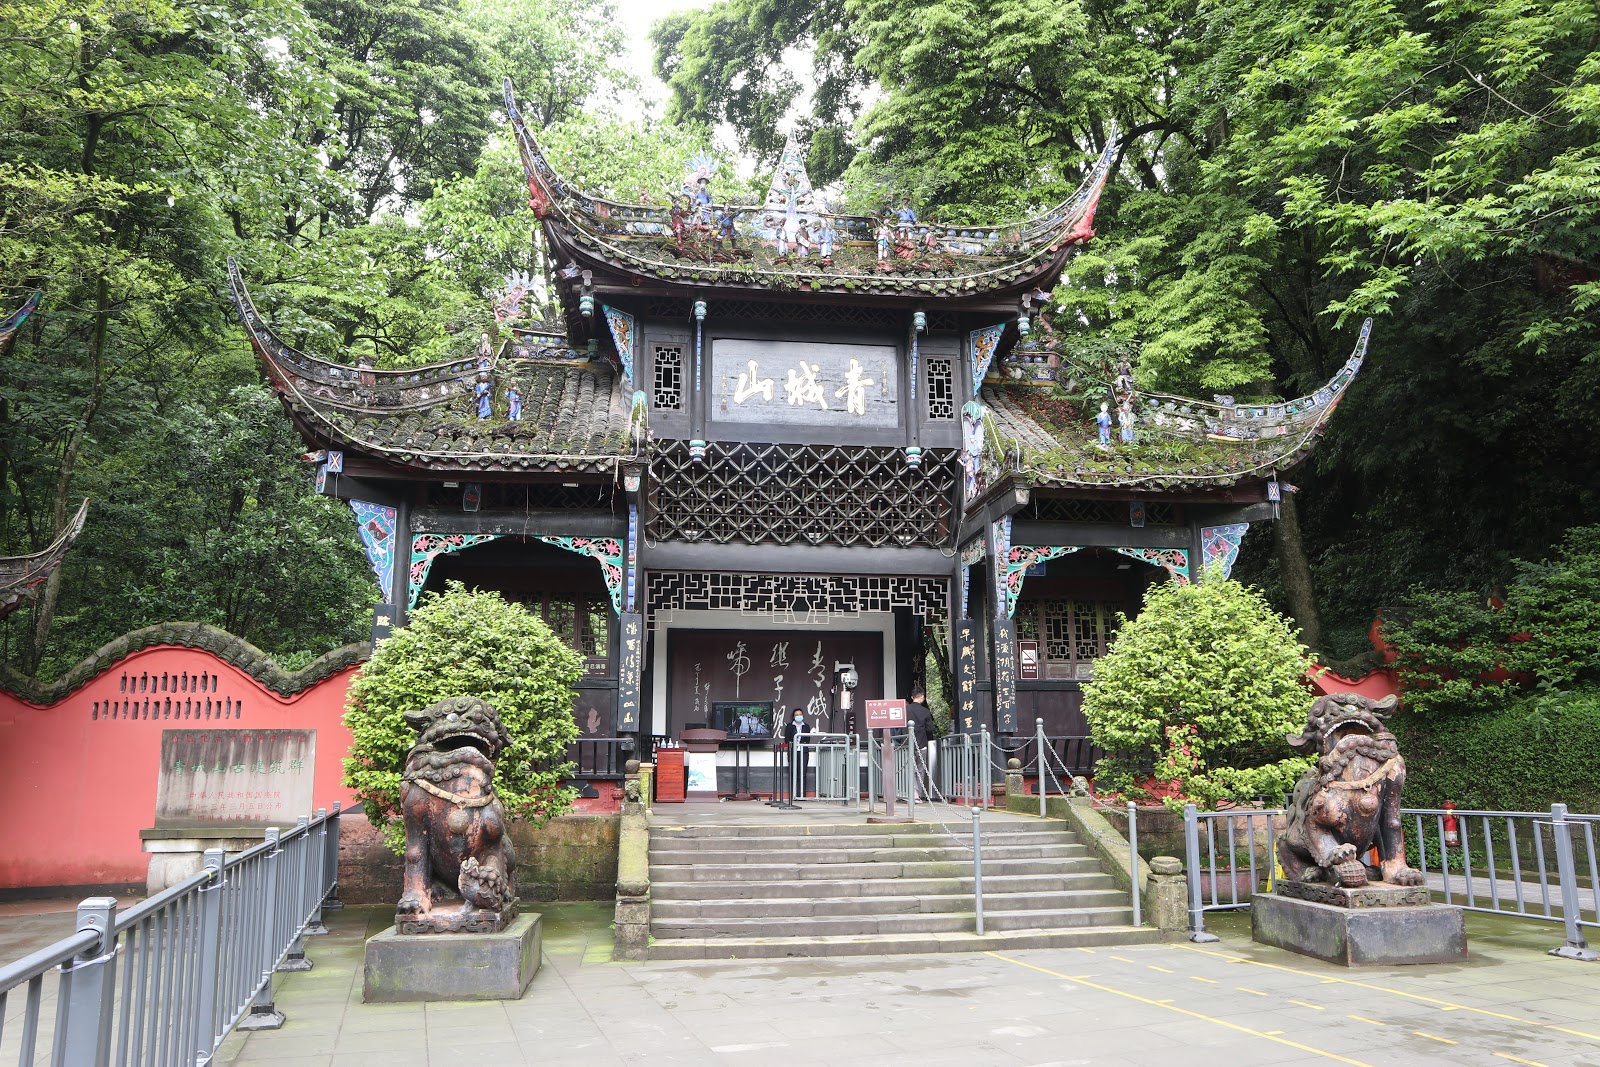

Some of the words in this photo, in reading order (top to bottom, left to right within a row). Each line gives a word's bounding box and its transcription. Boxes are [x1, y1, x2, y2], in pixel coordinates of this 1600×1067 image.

[733, 358, 874, 416] 青城山
[173, 759, 304, 777] 青城山古建筑群
